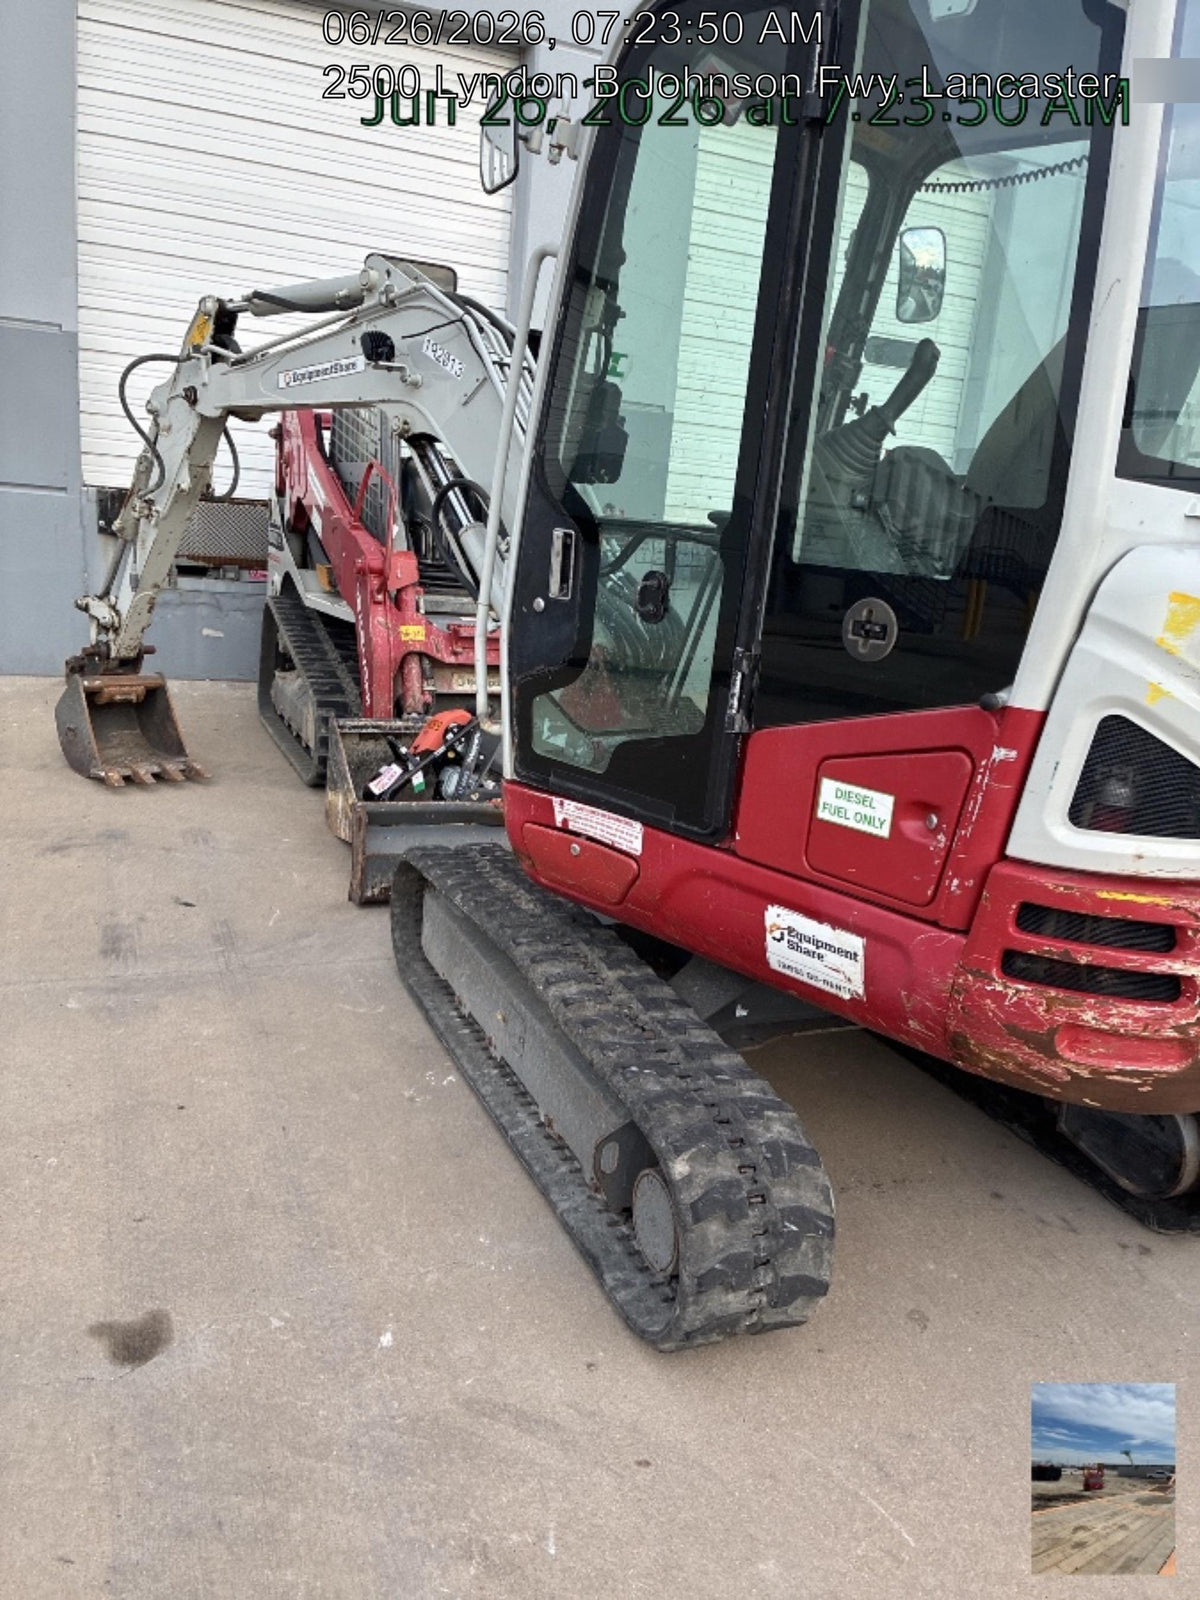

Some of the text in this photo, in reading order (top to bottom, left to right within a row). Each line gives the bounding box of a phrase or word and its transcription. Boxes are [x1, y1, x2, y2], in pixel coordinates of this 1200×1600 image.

[834, 787, 876, 810] DIESEL
[821, 801, 886, 830] FUEL ONLY
[787, 925, 860, 963] Equipment
[787, 938, 824, 962] Share
